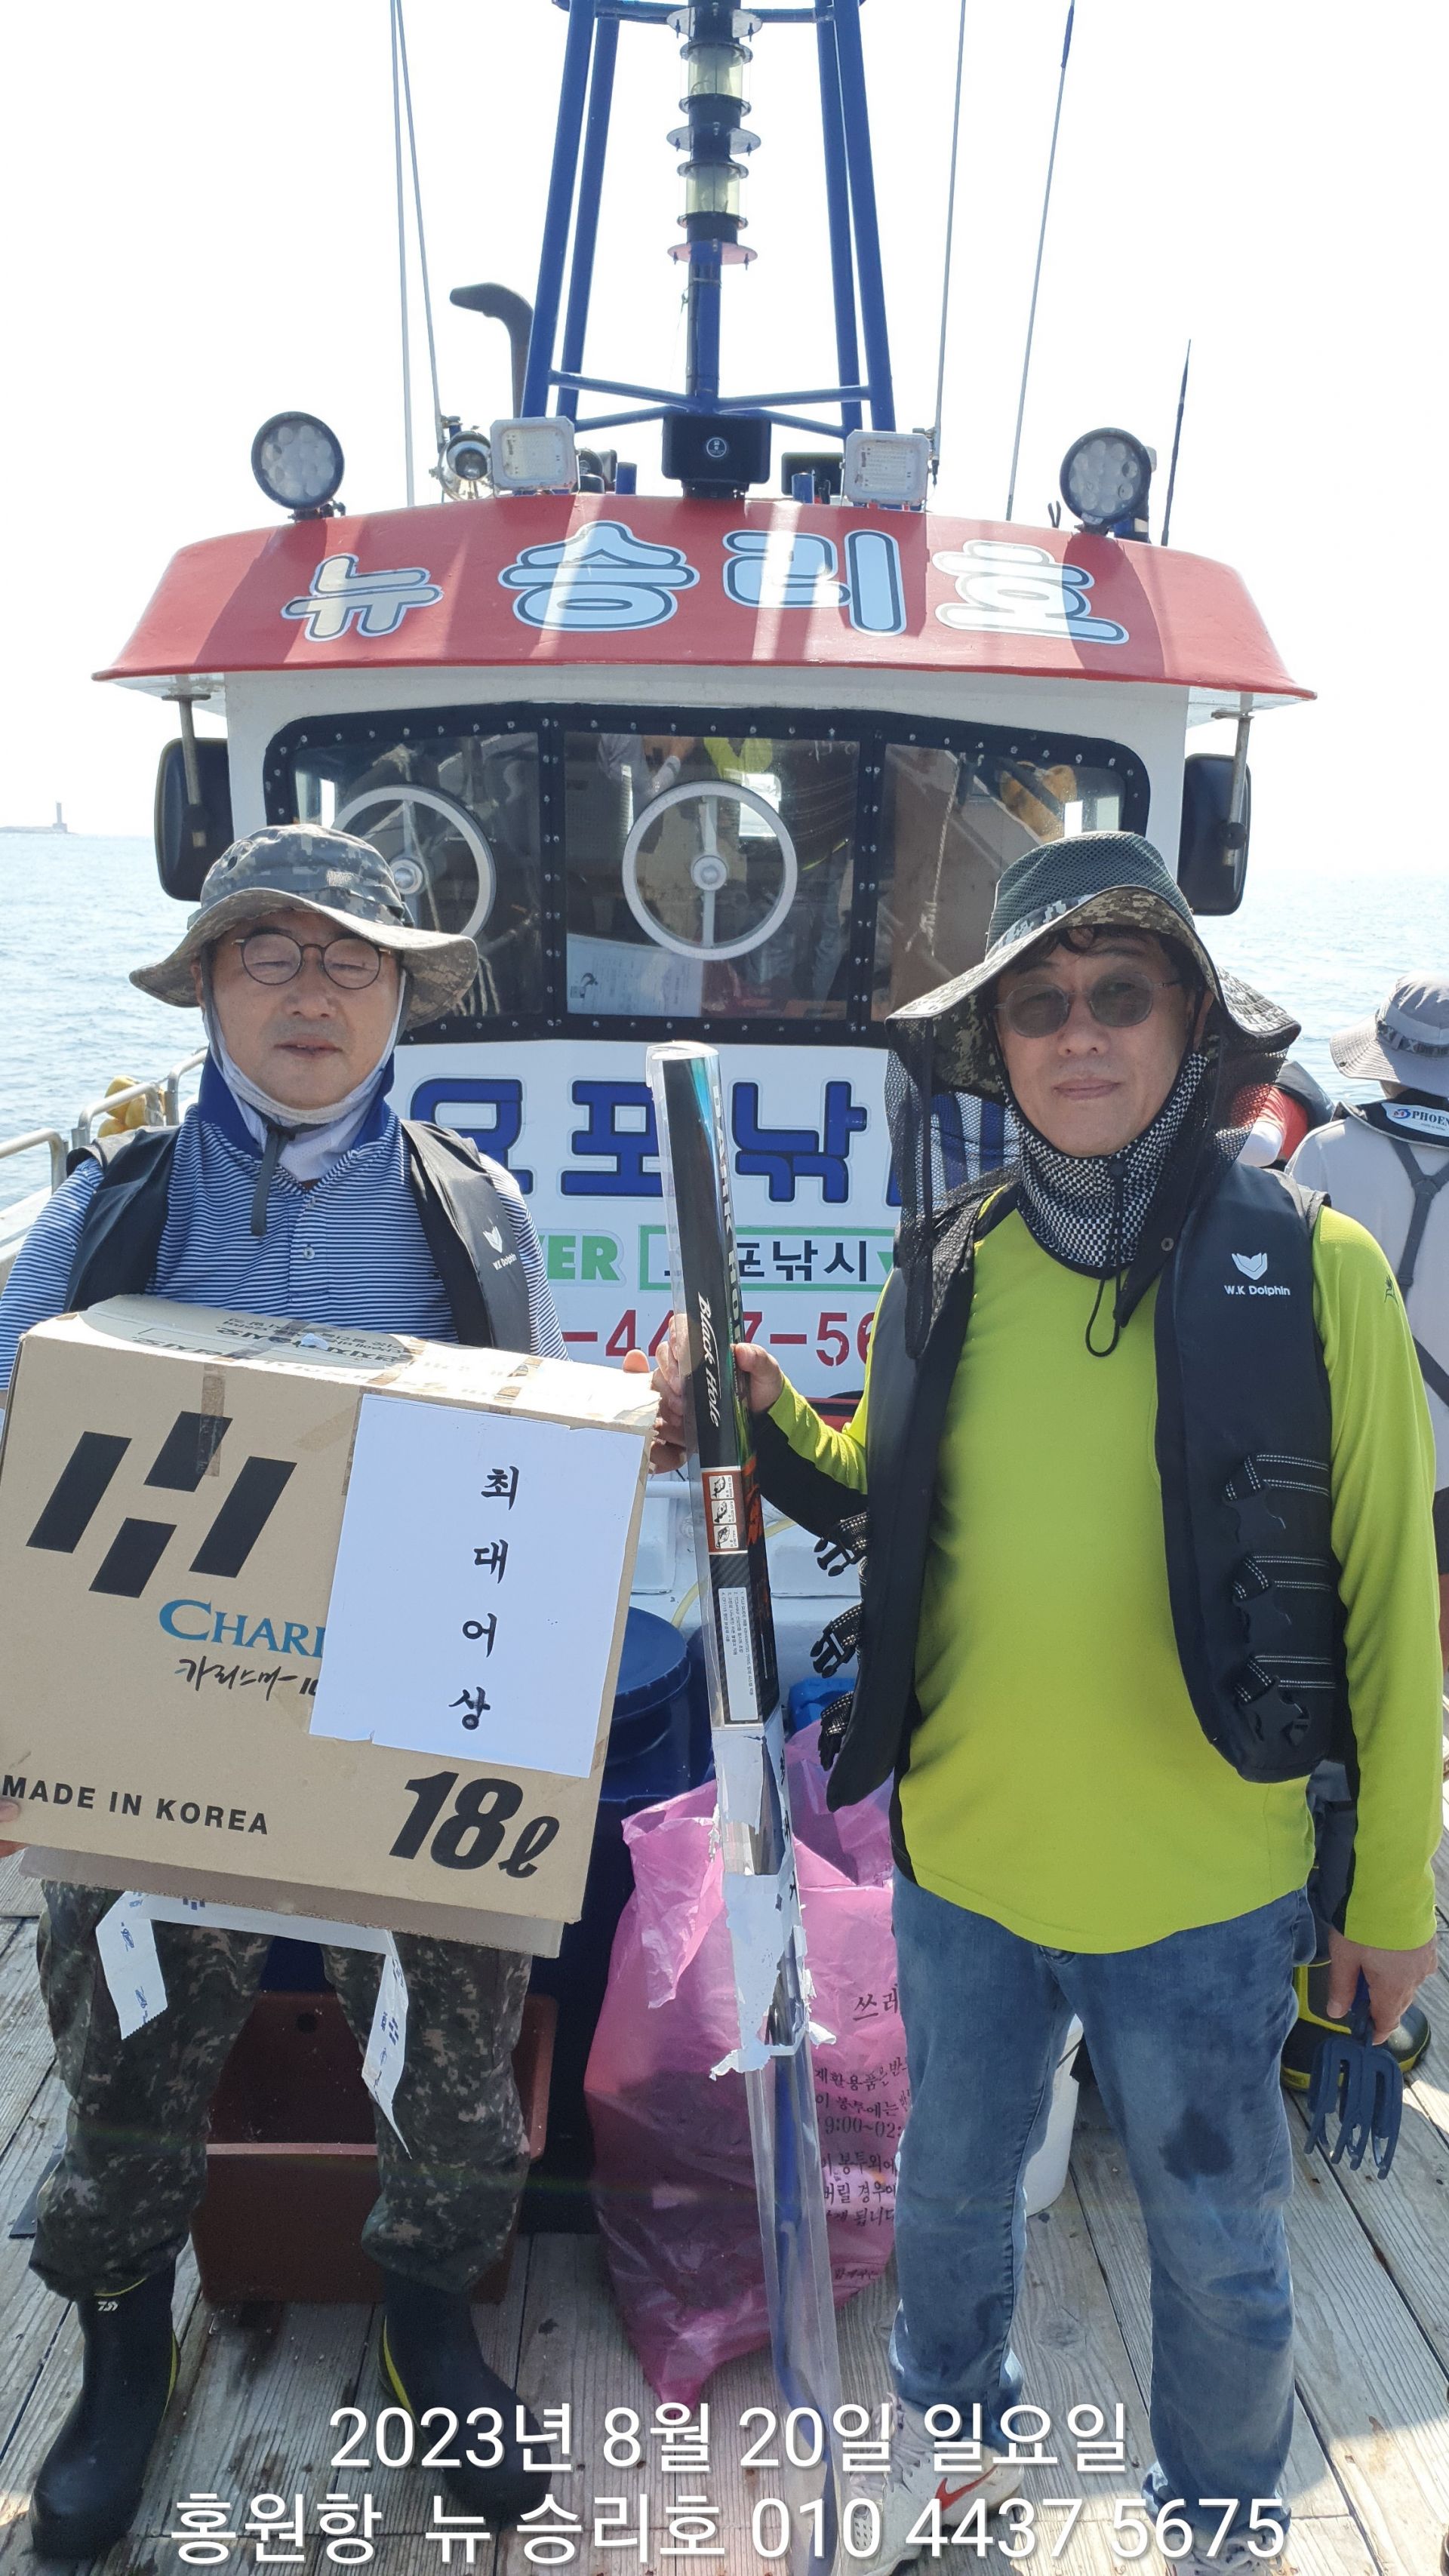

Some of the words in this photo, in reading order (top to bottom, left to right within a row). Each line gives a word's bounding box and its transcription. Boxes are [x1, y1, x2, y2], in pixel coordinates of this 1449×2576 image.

[281, 553, 444, 642] 뉴
[498, 520, 1130, 644] 승리호
[1224, 1285, 1246, 1296] W.K
[1248, 1285, 1291, 1296] Dolphin
[697, 1291, 721, 1366] Black
[705, 1366, 719, 1428] Hole
[2, 1775, 96, 1809] MADE
[109, 1791, 142, 1816] IN
[155, 1798, 268, 1835] KOREA
